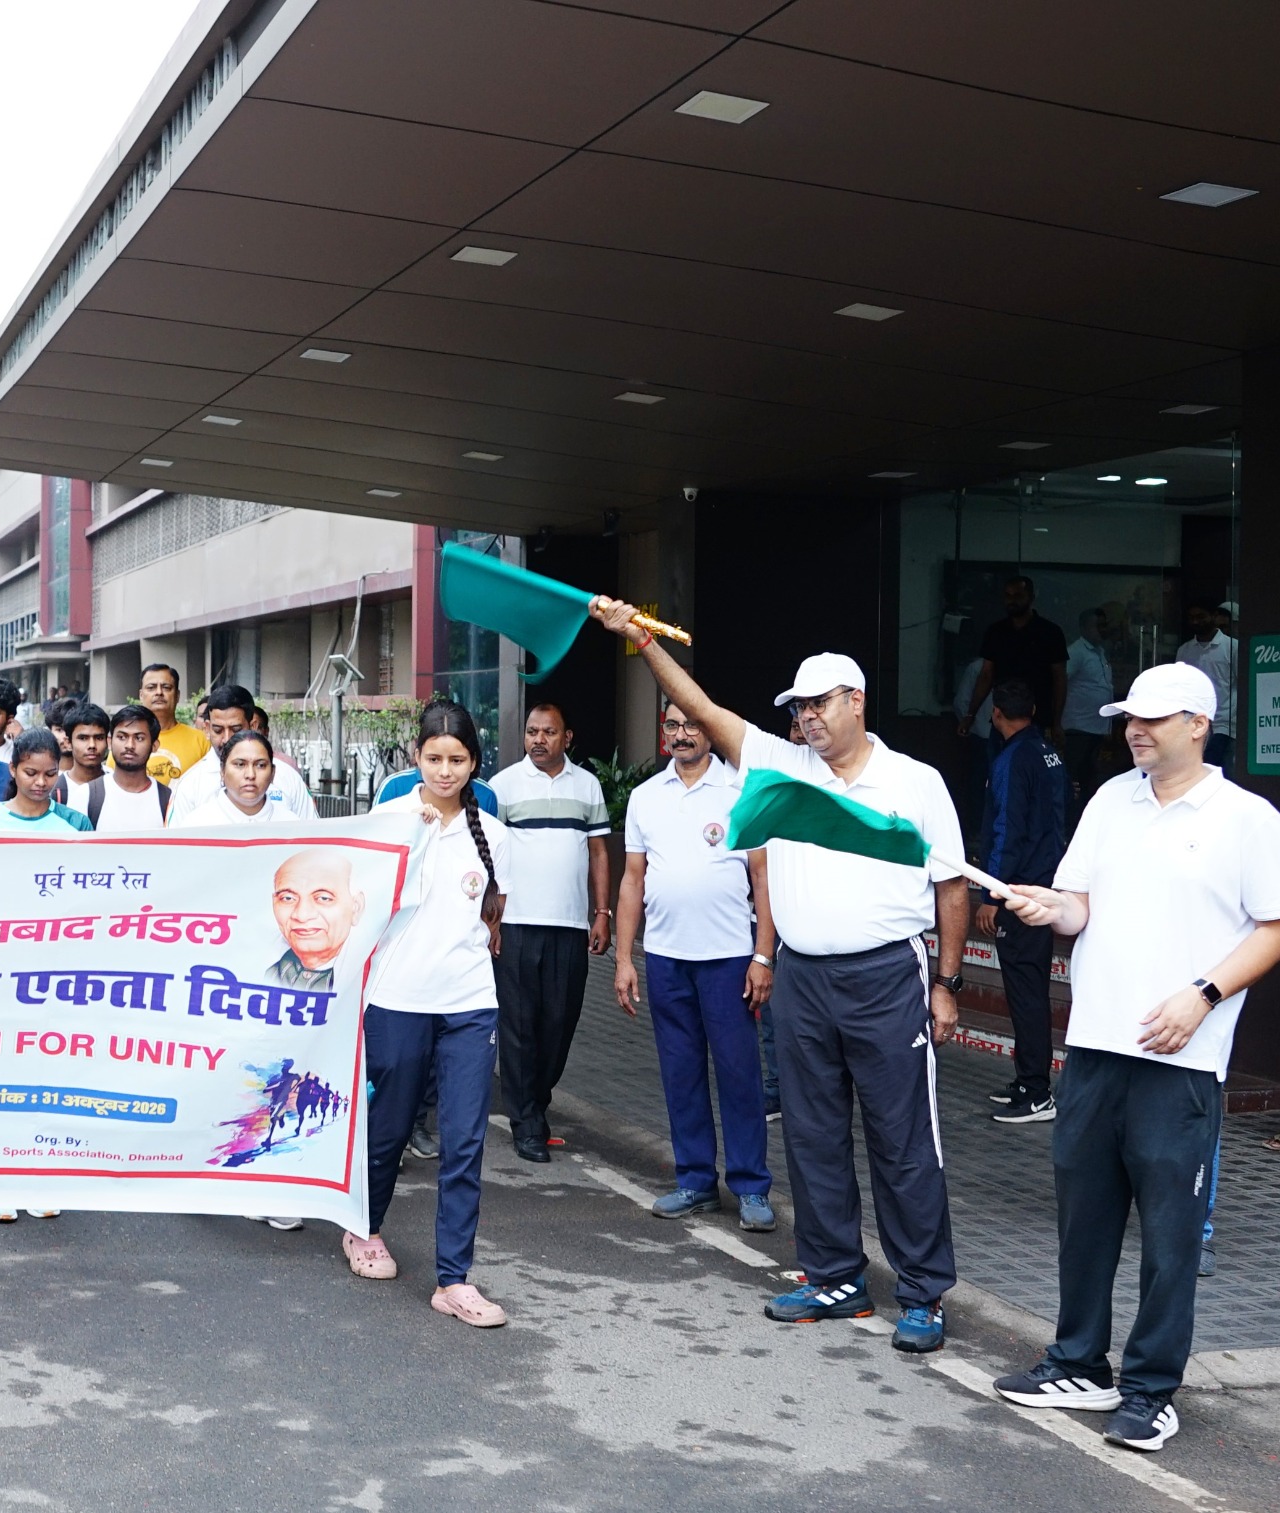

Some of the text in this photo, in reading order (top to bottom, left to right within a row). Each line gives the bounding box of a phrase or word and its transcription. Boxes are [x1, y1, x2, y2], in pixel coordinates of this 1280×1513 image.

[1043, 753, 1062, 768] ECR
[34, 866, 151, 897] पूर्व मध्य रेल
[108, 904, 237, 945] मंडल
[11, 969, 174, 1011] एकता
[185, 964, 338, 1027] दिवस
[16, 1031, 94, 1057] FOR
[109, 1037, 227, 1071] UNITY
[42, 1092, 59, 1105] 31
[61, 1094, 132, 1116] अक्टूबर
[131, 1101, 167, 1116] 2026
[2, 1146, 44, 1157] Sports
[48, 1148, 125, 1162] Association,
[128, 1153, 183, 1162] Dhanbad
[34, 1134, 61, 1146] Org.
[66, 1137, 82, 1147] By
